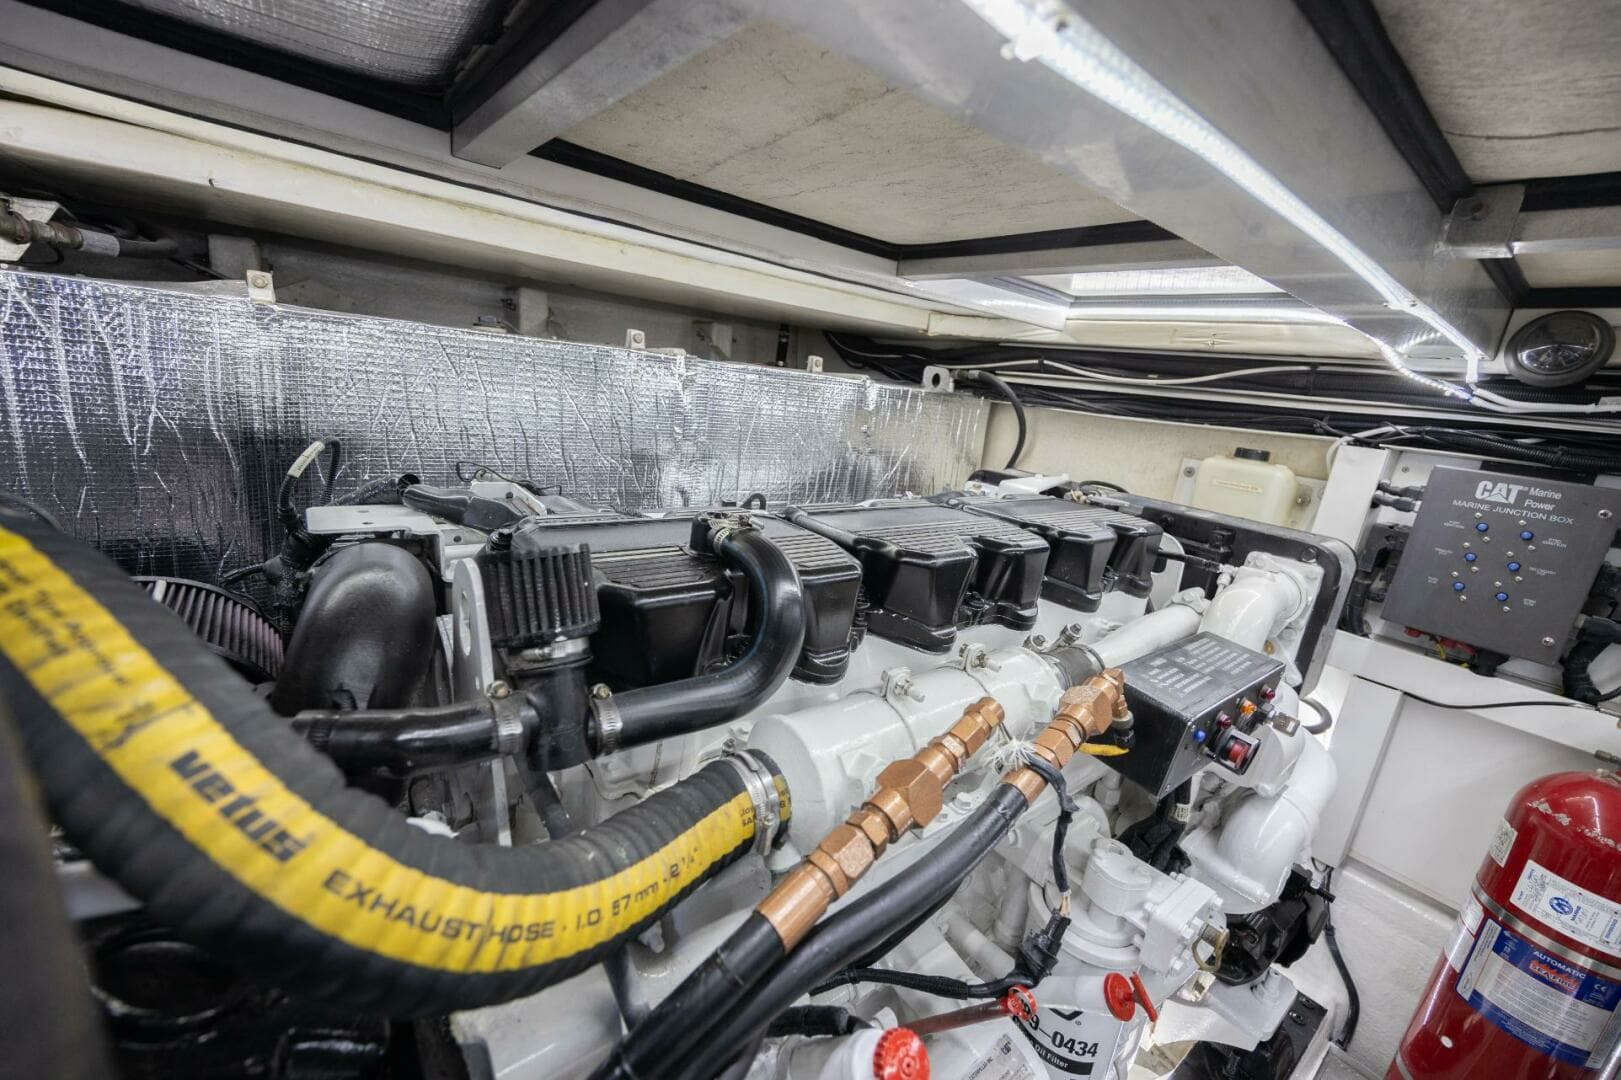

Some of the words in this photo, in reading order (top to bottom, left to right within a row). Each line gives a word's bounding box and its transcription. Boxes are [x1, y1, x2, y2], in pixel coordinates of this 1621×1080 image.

[1475, 481, 1521, 505] CAT
[1528, 487, 1562, 500] Marine
[1524, 499, 1556, 511] Power
[1452, 499, 1491, 511] MARINE
[1493, 506, 1547, 520] JUNCTION
[1549, 514, 1574, 525] BOX
[170, 750, 306, 864] vetus
[322, 868, 482, 941] EXHAUST
[487, 920, 556, 944] HOSE
[612, 893, 632, 917] 57
[1532, 950, 1587, 980] AUTOMATIC
[1046, 1052, 1069, 1069] Filter
